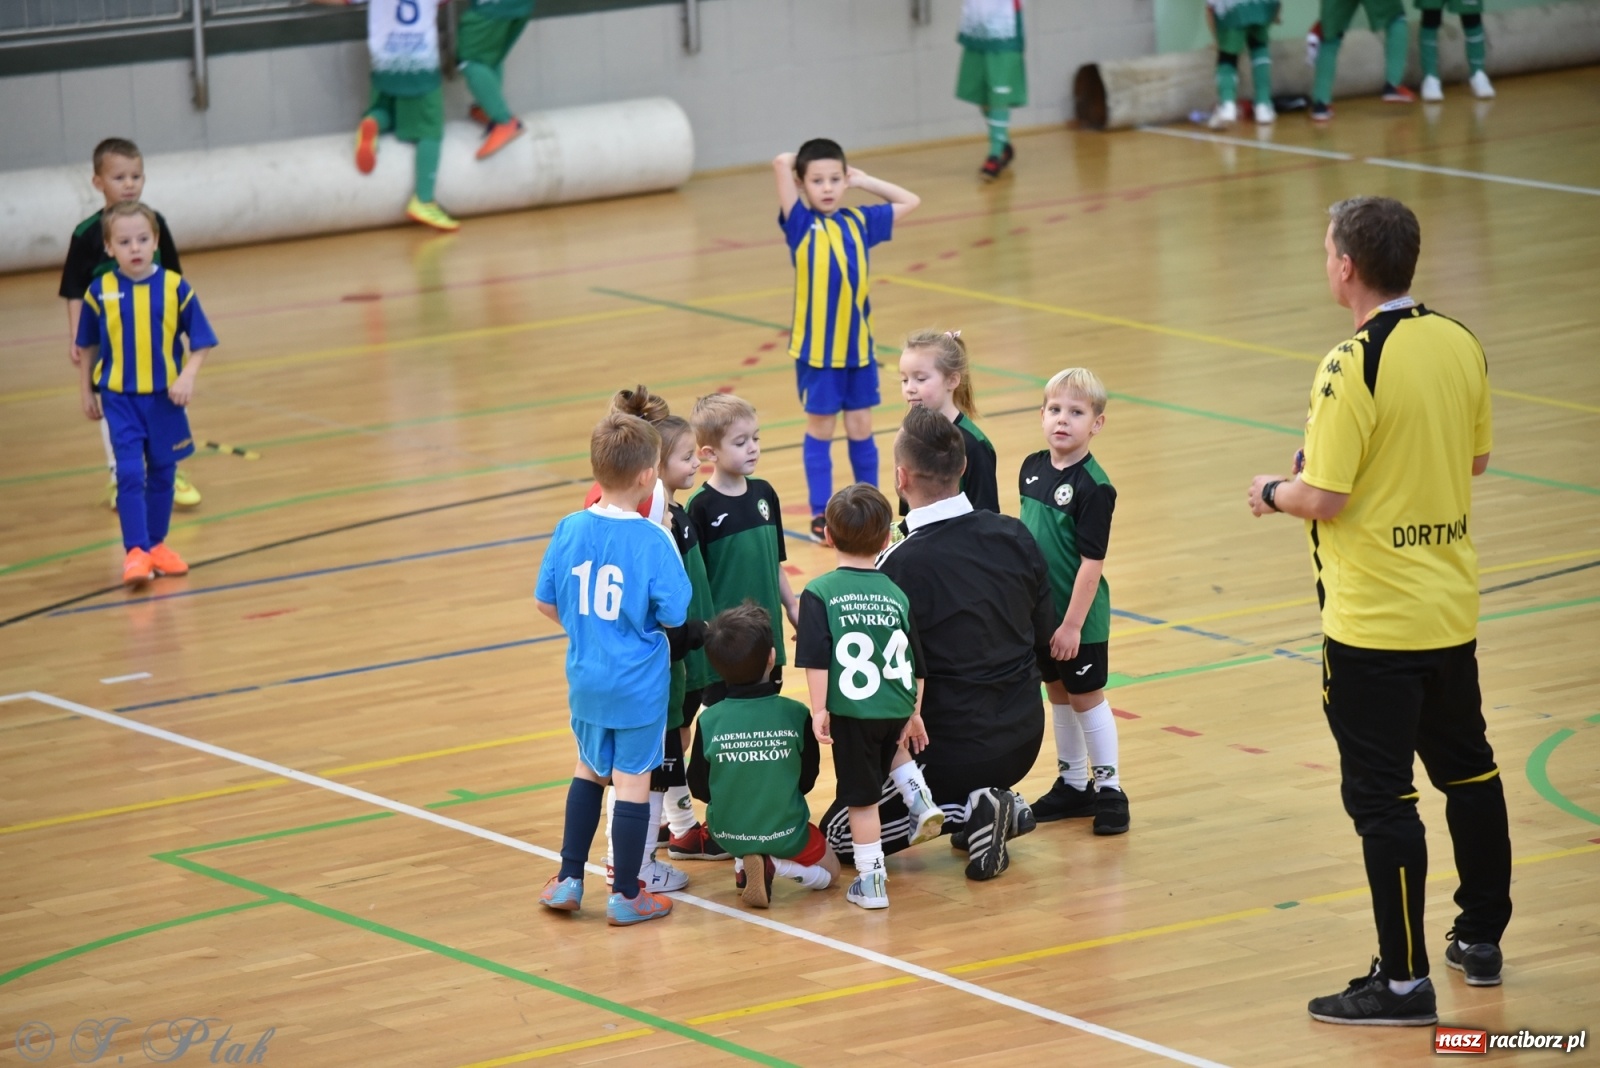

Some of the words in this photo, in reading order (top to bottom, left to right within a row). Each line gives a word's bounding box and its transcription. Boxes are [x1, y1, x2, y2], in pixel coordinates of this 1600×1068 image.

[1392, 513, 1467, 548] DORTMUN
[571, 559, 624, 621] 16
[829, 593, 869, 606] AKADEMIA
[835, 628, 913, 701] 84
[752, 730, 799, 739] PIŁKARSKA
[720, 740, 763, 751] MŁODEGO
[715, 747, 792, 763] TWORKÓW
